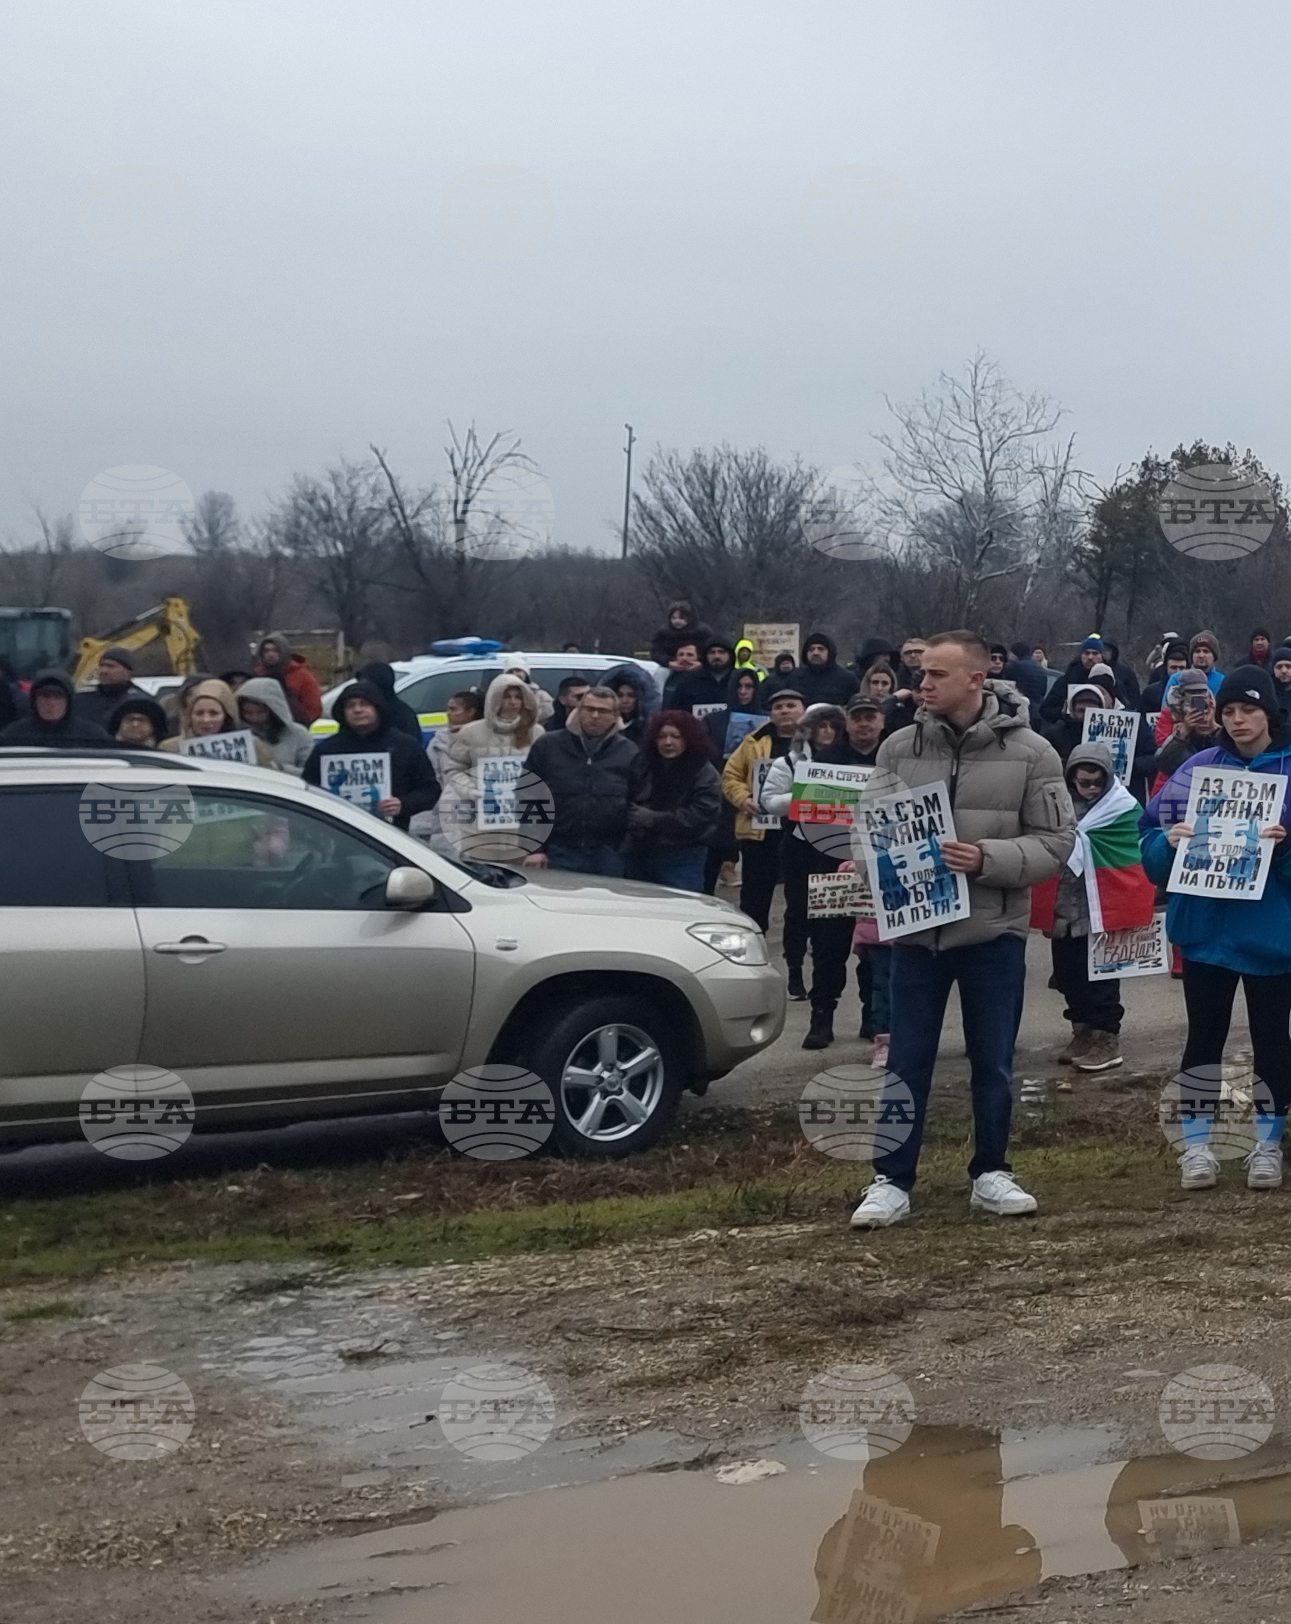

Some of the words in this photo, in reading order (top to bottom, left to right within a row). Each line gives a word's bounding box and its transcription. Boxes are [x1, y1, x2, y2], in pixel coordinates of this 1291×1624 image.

[1090, 712, 1104, 723] АЗ
[1108, 714, 1135, 727] СЪМ
[1088, 722, 1133, 739] СИЯНА!
[328, 760, 345, 772] АЗ
[351, 758, 383, 772] СЪМ
[807, 768, 834, 779] НЕКА
[1198, 777, 1224, 796] АЗ
[1231, 779, 1277, 801] СЪМ
[865, 807, 889, 832] АЗ
[894, 792, 942, 822] СЪМ
[1196, 797, 1273, 821] СИЯНА!
[870, 813, 946, 853] СИЯНА!
[1178, 871, 1199, 886] НА
[886, 911, 906, 929] НА
